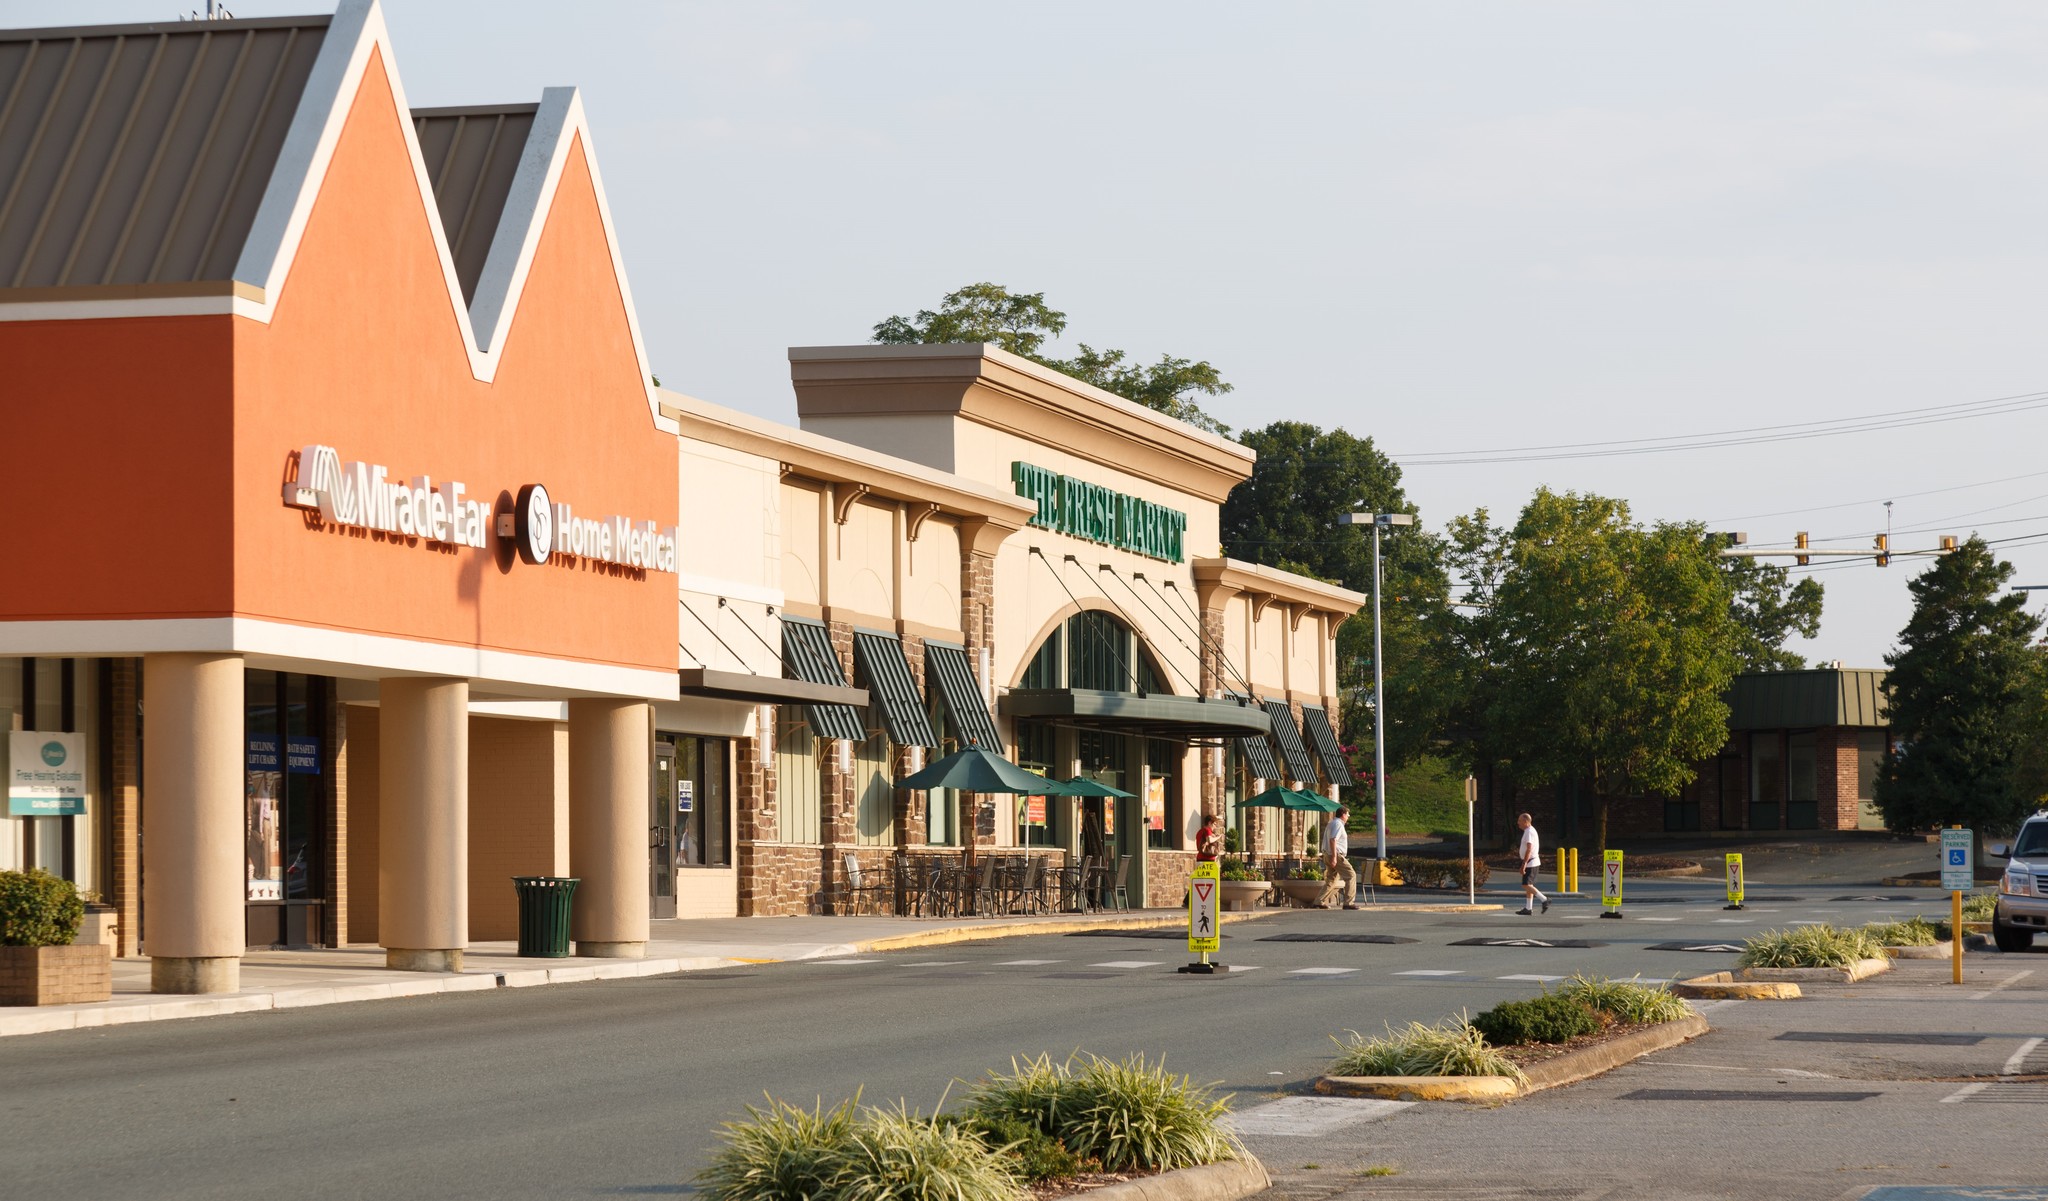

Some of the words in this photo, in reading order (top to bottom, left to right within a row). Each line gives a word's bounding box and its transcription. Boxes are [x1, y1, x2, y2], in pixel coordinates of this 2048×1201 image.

[348, 461, 490, 548] Miracle-Ear
[1012, 461, 1058, 530] THE
[1058, 475, 1117, 546] FRESH
[1117, 493, 1187, 564] MARKET
[556, 502, 612, 563] Home
[613, 515, 679, 574] Medical
[250, 741, 276, 752] RECLINING
[287, 743, 300, 754] BATH
[299, 744, 316, 755] SAFETY
[249, 754, 260, 764] LIFT
[260, 755, 277, 765] CHAIRS
[289, 756, 315, 768] EQUIPMENT
